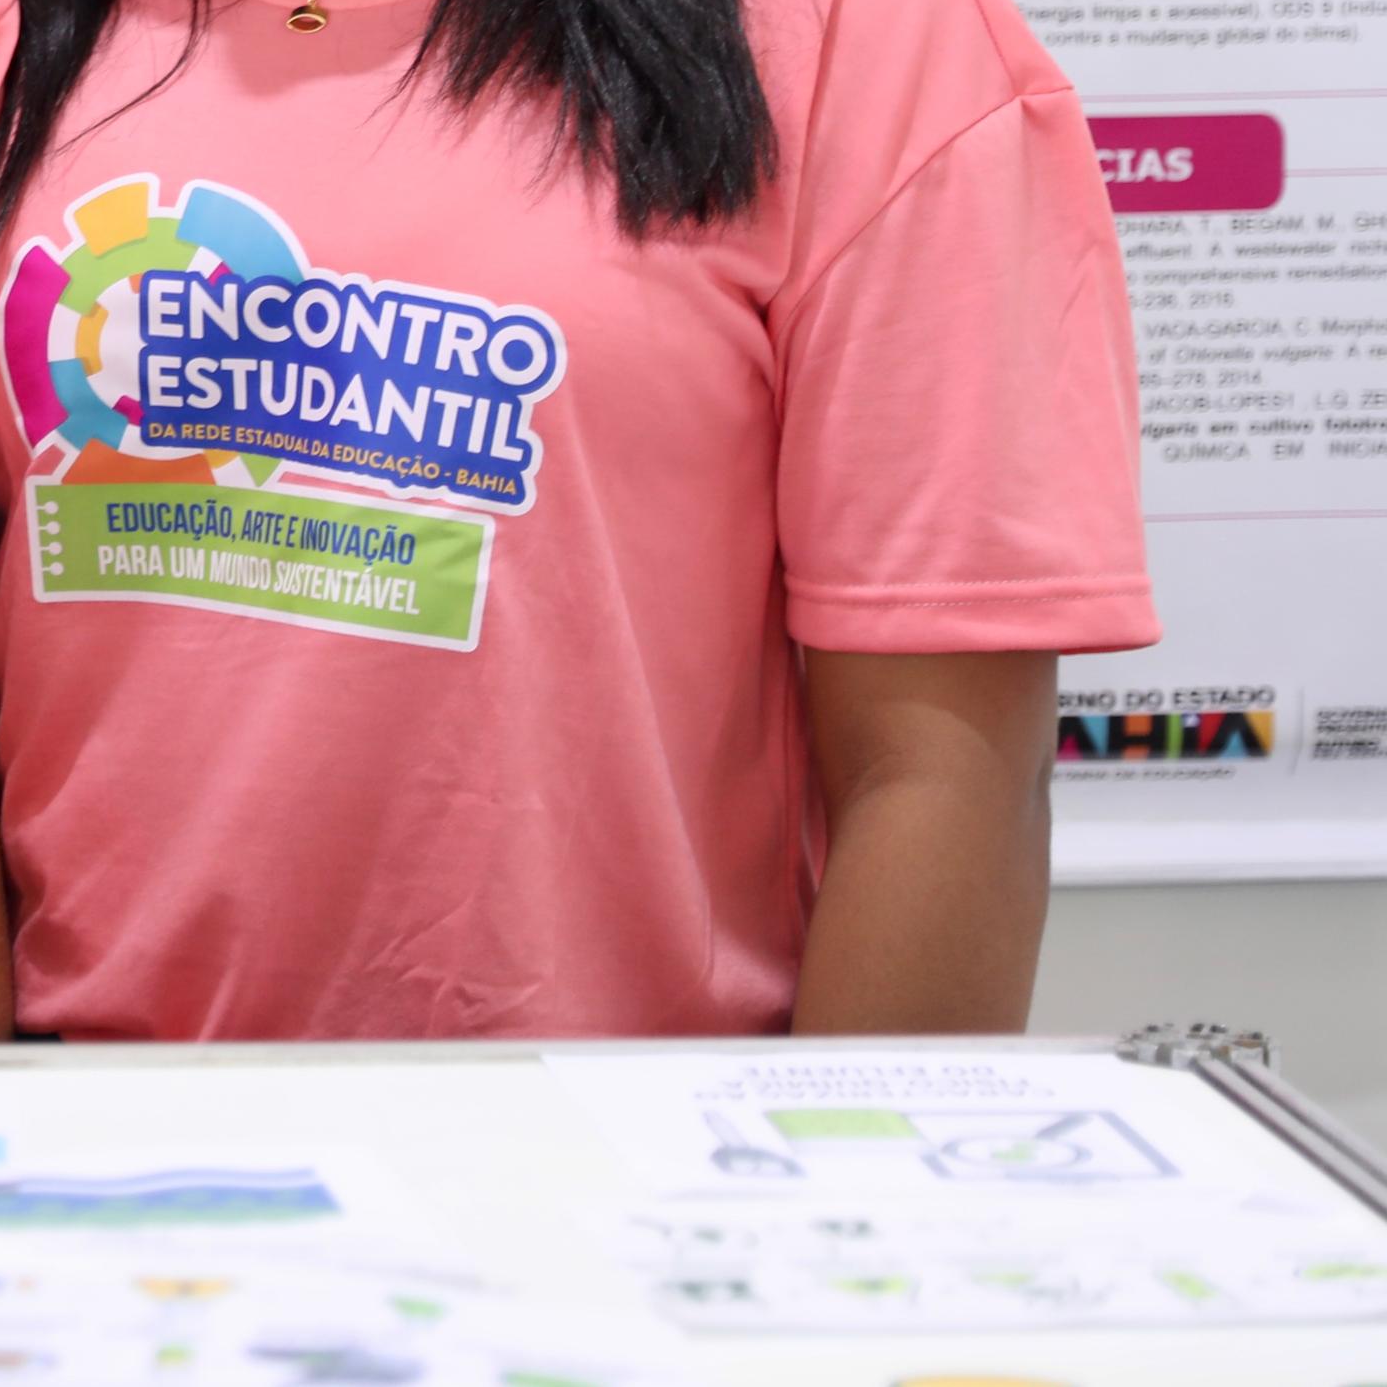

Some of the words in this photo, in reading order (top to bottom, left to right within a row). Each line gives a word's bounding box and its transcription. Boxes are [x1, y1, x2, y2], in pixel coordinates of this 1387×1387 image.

[147, 278, 548, 386] ENCONTRO
[146, 355, 524, 462] ESTUDANTIL
[149, 422, 176, 439] DA
[182, 423, 230, 441] REDE
[235, 428, 308, 454] ESTADUAL
[310, 439, 328, 458] DA
[332, 444, 439, 482] EDUCAÇÃO
[455, 468, 517, 495] BAHIA
[107, 500, 236, 543] EDUCAÇÃO,
[241, 510, 284, 547] ARTE
[285, 516, 299, 548] E
[300, 518, 416, 566] INOVAÇÃO
[98, 544, 164, 577] PARA
[171, 546, 204, 580] UM
[209, 550, 271, 590] MUNDO
[274, 560, 420, 615] SUSTENTÁVEL
[1057, 710, 1276, 761] AHIA
